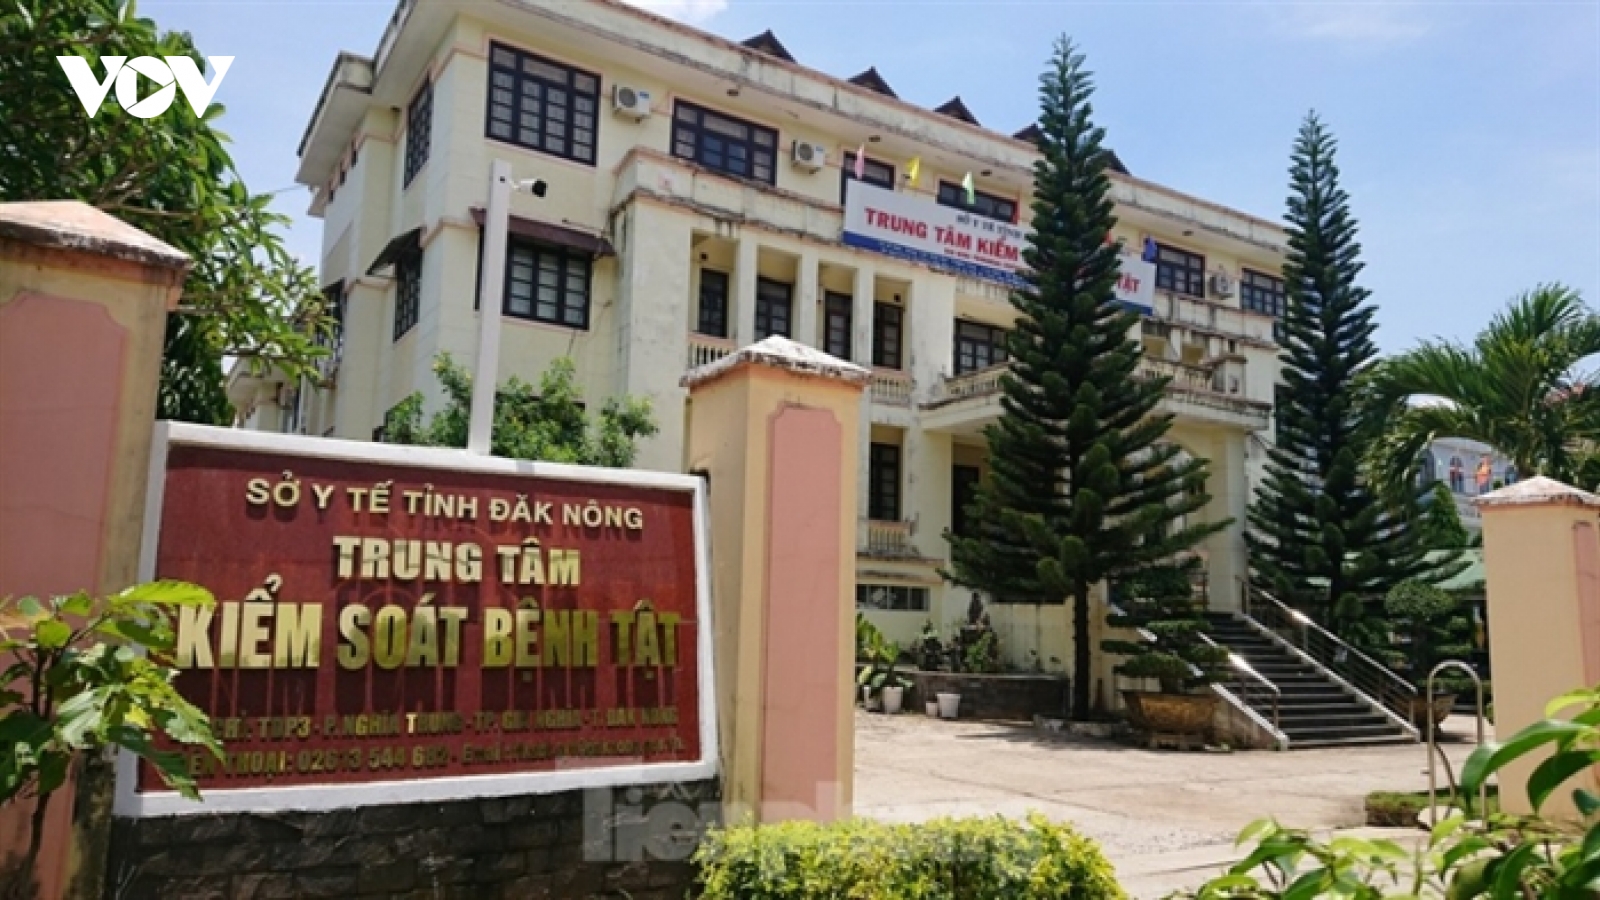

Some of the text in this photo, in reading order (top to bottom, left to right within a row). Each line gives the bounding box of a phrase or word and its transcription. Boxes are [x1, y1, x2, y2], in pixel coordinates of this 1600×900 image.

[864, 206, 927, 239] TRUNG
[934, 223, 972, 251] TÂM
[977, 232, 1019, 262] KIỂM
[246, 470, 301, 507] SỞ
[312, 484, 335, 509] Y
[347, 479, 393, 513] TẾ
[403, 483, 478, 519] TỈNH
[562, 499, 643, 530] NÔNG
[333, 535, 581, 586] TRUNG TÂM
[176, 573, 681, 682] KIỂM SOÁT BỆNH TẬT
